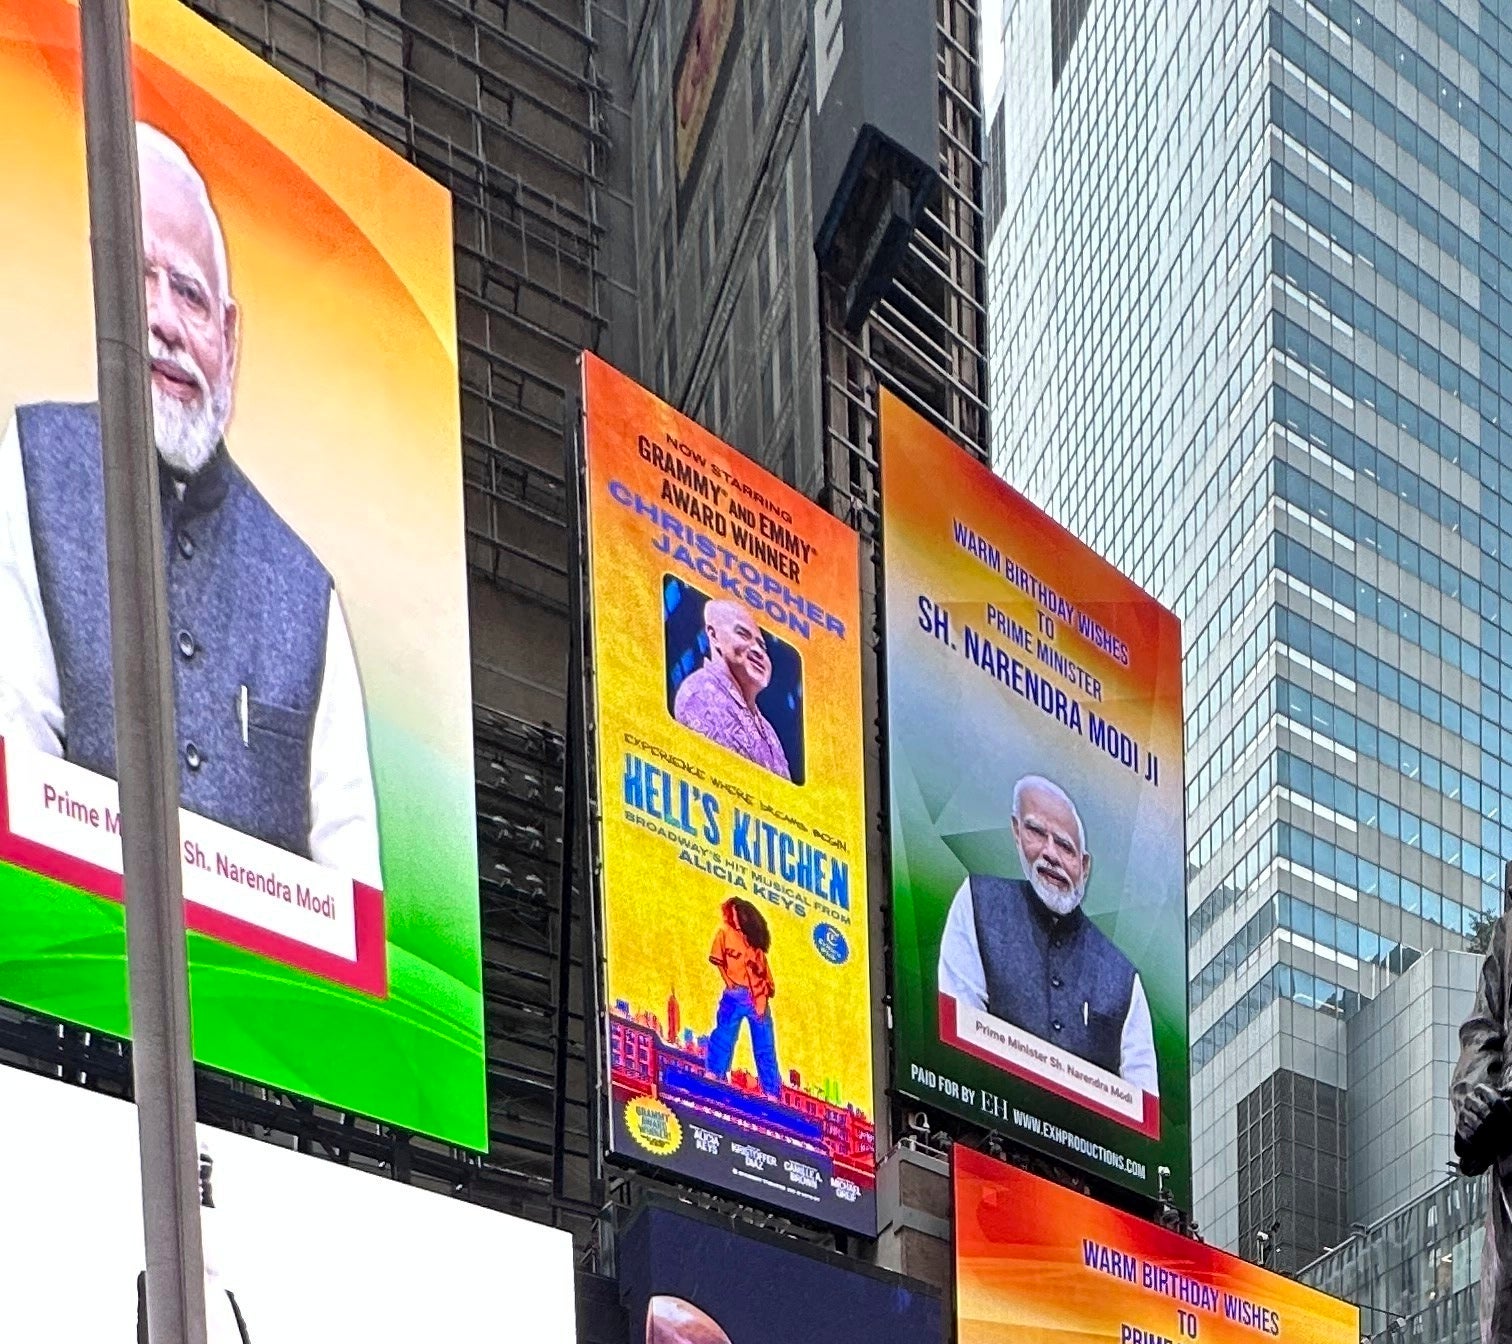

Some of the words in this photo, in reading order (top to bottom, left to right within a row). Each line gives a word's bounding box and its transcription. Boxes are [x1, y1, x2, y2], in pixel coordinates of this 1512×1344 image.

[666, 432, 708, 470] NOW
[710, 463, 793, 525] STARRING
[729, 495, 757, 528] AND
[608, 480, 847, 641] CHRISTOPHER
[660, 477, 727, 538] AWARD
[731, 524, 801, 585] WINNER
[651, 535, 811, 641] JACKSON
[953, 517, 1001, 573] WARM
[1005, 559, 1075, 624] BIRTHDAY
[1078, 610, 1129, 666] WISHES
[1036, 609, 1056, 640] TO
[917, 594, 957, 651] SH.
[964, 624, 1083, 736] NARENDRA
[1088, 713, 1139, 774] MODI
[1144, 750, 1160, 787] JI
[986, 602, 1033, 654] PRIME
[1036, 638, 1103, 703] MINISTER
[623, 751, 721, 846] HELL'S
[733, 805, 849, 911] KITCHEN
[711, 776, 755, 806] WHERE
[43, 783, 102, 829] Prime
[183, 839, 212, 873] Sh.
[215, 854, 292, 904] Narendra
[295, 882, 336, 921] Modi
[624, 809, 722, 864] BROADWAY'S
[724, 857, 749, 877] HIT
[751, 870, 812, 909] MUSICAL
[813, 900, 852, 926] FROM
[678, 848, 747, 891] ALICIA
[752, 883, 807, 919] KEYS
[975, 1019, 1006, 1044] Prime
[1007, 1034, 1049, 1063] Minister
[1049, 1056, 1065, 1073] Sh.
[1067, 1063, 1109, 1094] Narendra
[1110, 1084, 1133, 1105] Modi
[911, 1063, 936, 1089] PAID
[938, 1076, 959, 1098] FOR
[961, 1085, 976, 1106] BY
[1012, 1107, 1147, 1181] WWW.EXHPRODUCTIONS.COM
[1082, 1238, 1138, 1285] WARM
[1142, 1261, 1219, 1314] BIRTHDAY
[1223, 1291, 1280, 1336] WISHES
[1177, 1308, 1198, 1340] TO
